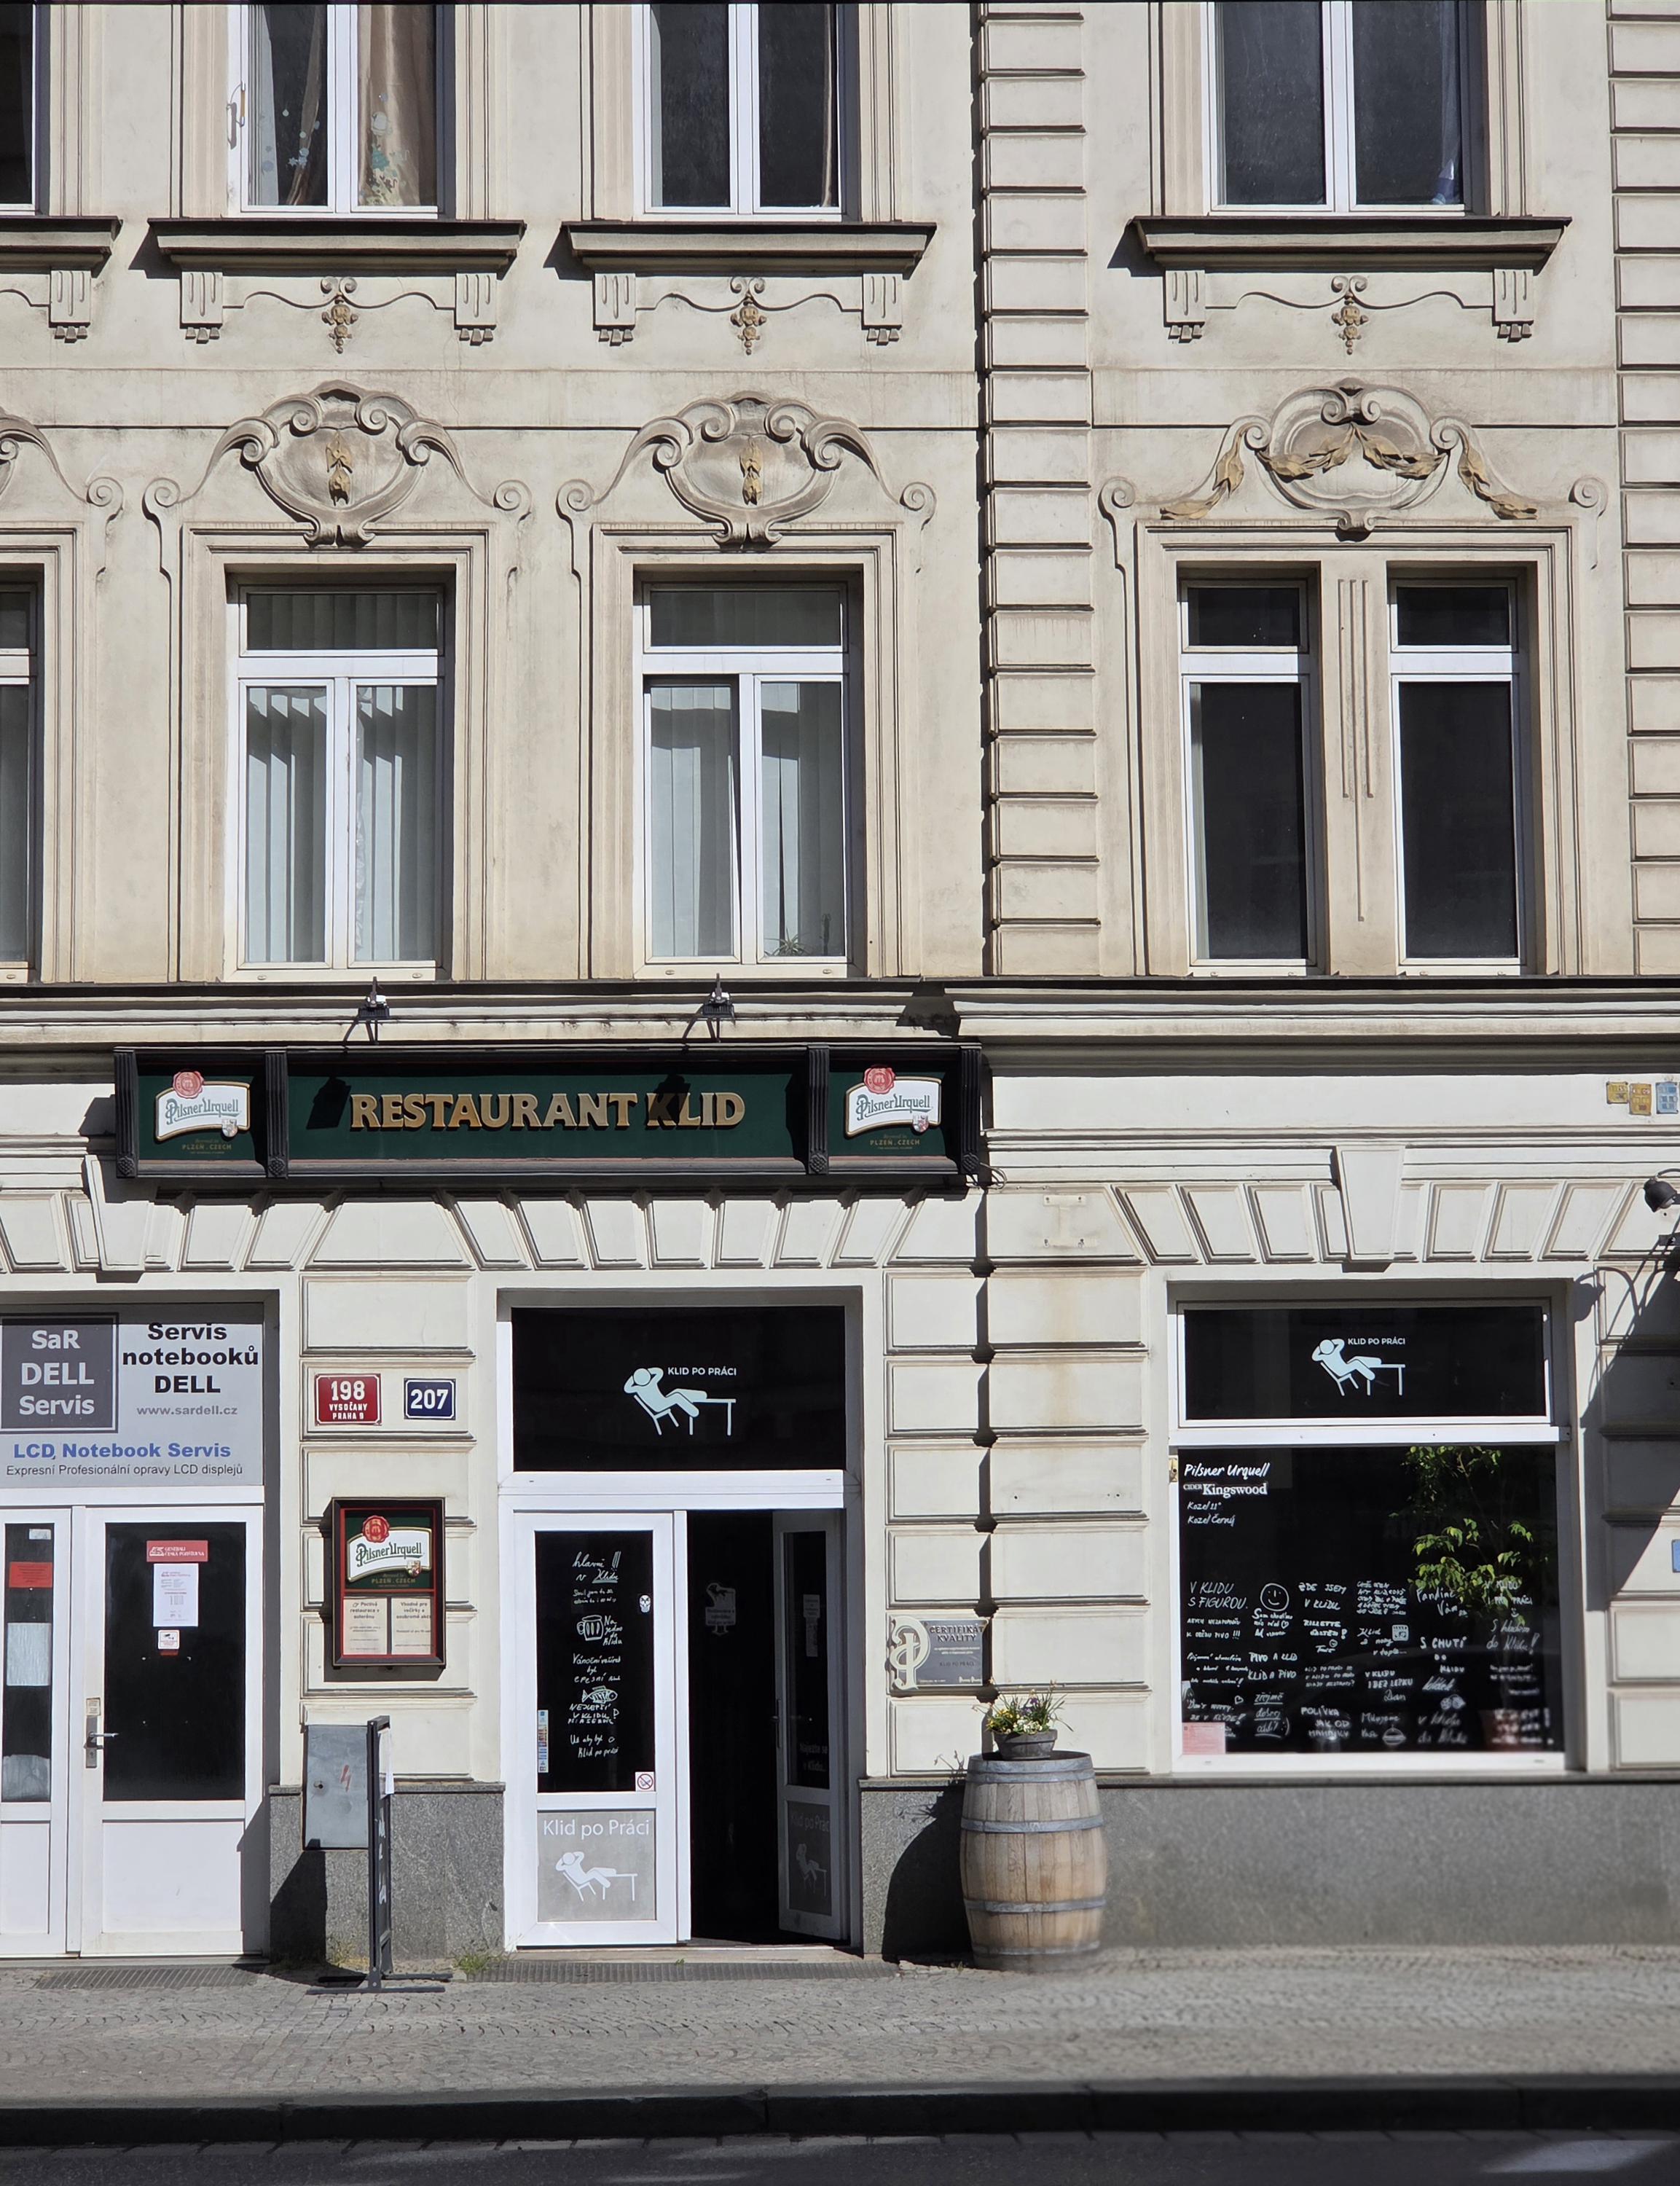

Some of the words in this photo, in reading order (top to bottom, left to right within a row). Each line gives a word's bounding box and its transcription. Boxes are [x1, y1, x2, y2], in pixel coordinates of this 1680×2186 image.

[165, 1098, 204, 1125] Pilsner
[203, 1098, 239, 1117] Urquell
[350, 1093, 638, 1129] RESTAURANT
[647, 1093, 746, 1128] KLID
[855, 1094, 895, 1121] Pilsner
[893, 1094, 930, 1113] Urquell
[148, 1323, 227, 1340] Servis
[32, 1330, 80, 1349] SaR
[1381, 1336, 1406, 1345] PRÁCI
[122, 1345, 259, 1366] notebooků
[21, 1362, 95, 1385] DELL
[667, 1367, 689, 1376] KLID
[691, 1368, 705, 1376] PO
[708, 1366, 737, 1376] PRÁCI
[154, 1376, 221, 1393] DELL
[331, 1380, 365, 1401] 198
[19, 1395, 95, 1416] Servis
[329, 1401, 367, 1411] VYSOČANY
[410, 1389, 449, 1410] 207
[137, 1405, 238, 1415] www.sardell.cz
[332, 1412, 357, 1420] PRAHA
[359, 1412, 364, 1420] 9
[63, 1443, 161, 1458] Notebook
[168, 1443, 231, 1457] Servis
[7, 1465, 55, 1477] Expresní
[59, 1464, 130, 1476] Profesionální
[133, 1466, 170, 1477] opravy
[174, 1464, 198, 1475] LCD
[201, 1463, 243, 1476] displejů
[1184, 1462, 1225, 1476] Pilsner
[1227, 1462, 1270, 1480] Urquell
[1202, 1482, 1268, 1499] Kingswood
[1188, 1501, 1210, 1510] Kozel
[1210, 1502, 1222, 1510] 11°
[1188, 1513, 1211, 1524] Kozel
[1211, 1513, 1236, 1527] Černý
[356, 1543, 390, 1567] Pilsner
[389, 1542, 422, 1559] Urquell
[1190, 1581, 1197, 1594] V
[1200, 1582, 1234, 1594] KLIDU
[1188, 1597, 1196, 1607] S
[1198, 1597, 1248, 1609] FIGUROU.
[1304, 1599, 1310, 1607] V
[1314, 1599, 1341, 1610] KLIDU
[930, 1623, 984, 1634] CERTIFIKÁT
[937, 1634, 976, 1642] KVALITY
[1420, 1636, 1426, 1649] S
[1432, 1636, 1467, 1648] CHUTÍ
[1249, 1652, 1268, 1662] PIVO
[1247, 1669, 1268, 1680] KLID
[1278, 1669, 1297, 1679] PIVO
[1373, 1680, 1388, 1688] BEZ
[1390, 1678, 1413, 1688] LEPKU
[1300, 1705, 1340, 1716] POLÍVKA
[1335, 1720, 1349, 1728] OD
[543, 1819, 576, 1836] Klid
[581, 1823, 603, 1840] po
[609, 1819, 650, 1836] Práci
